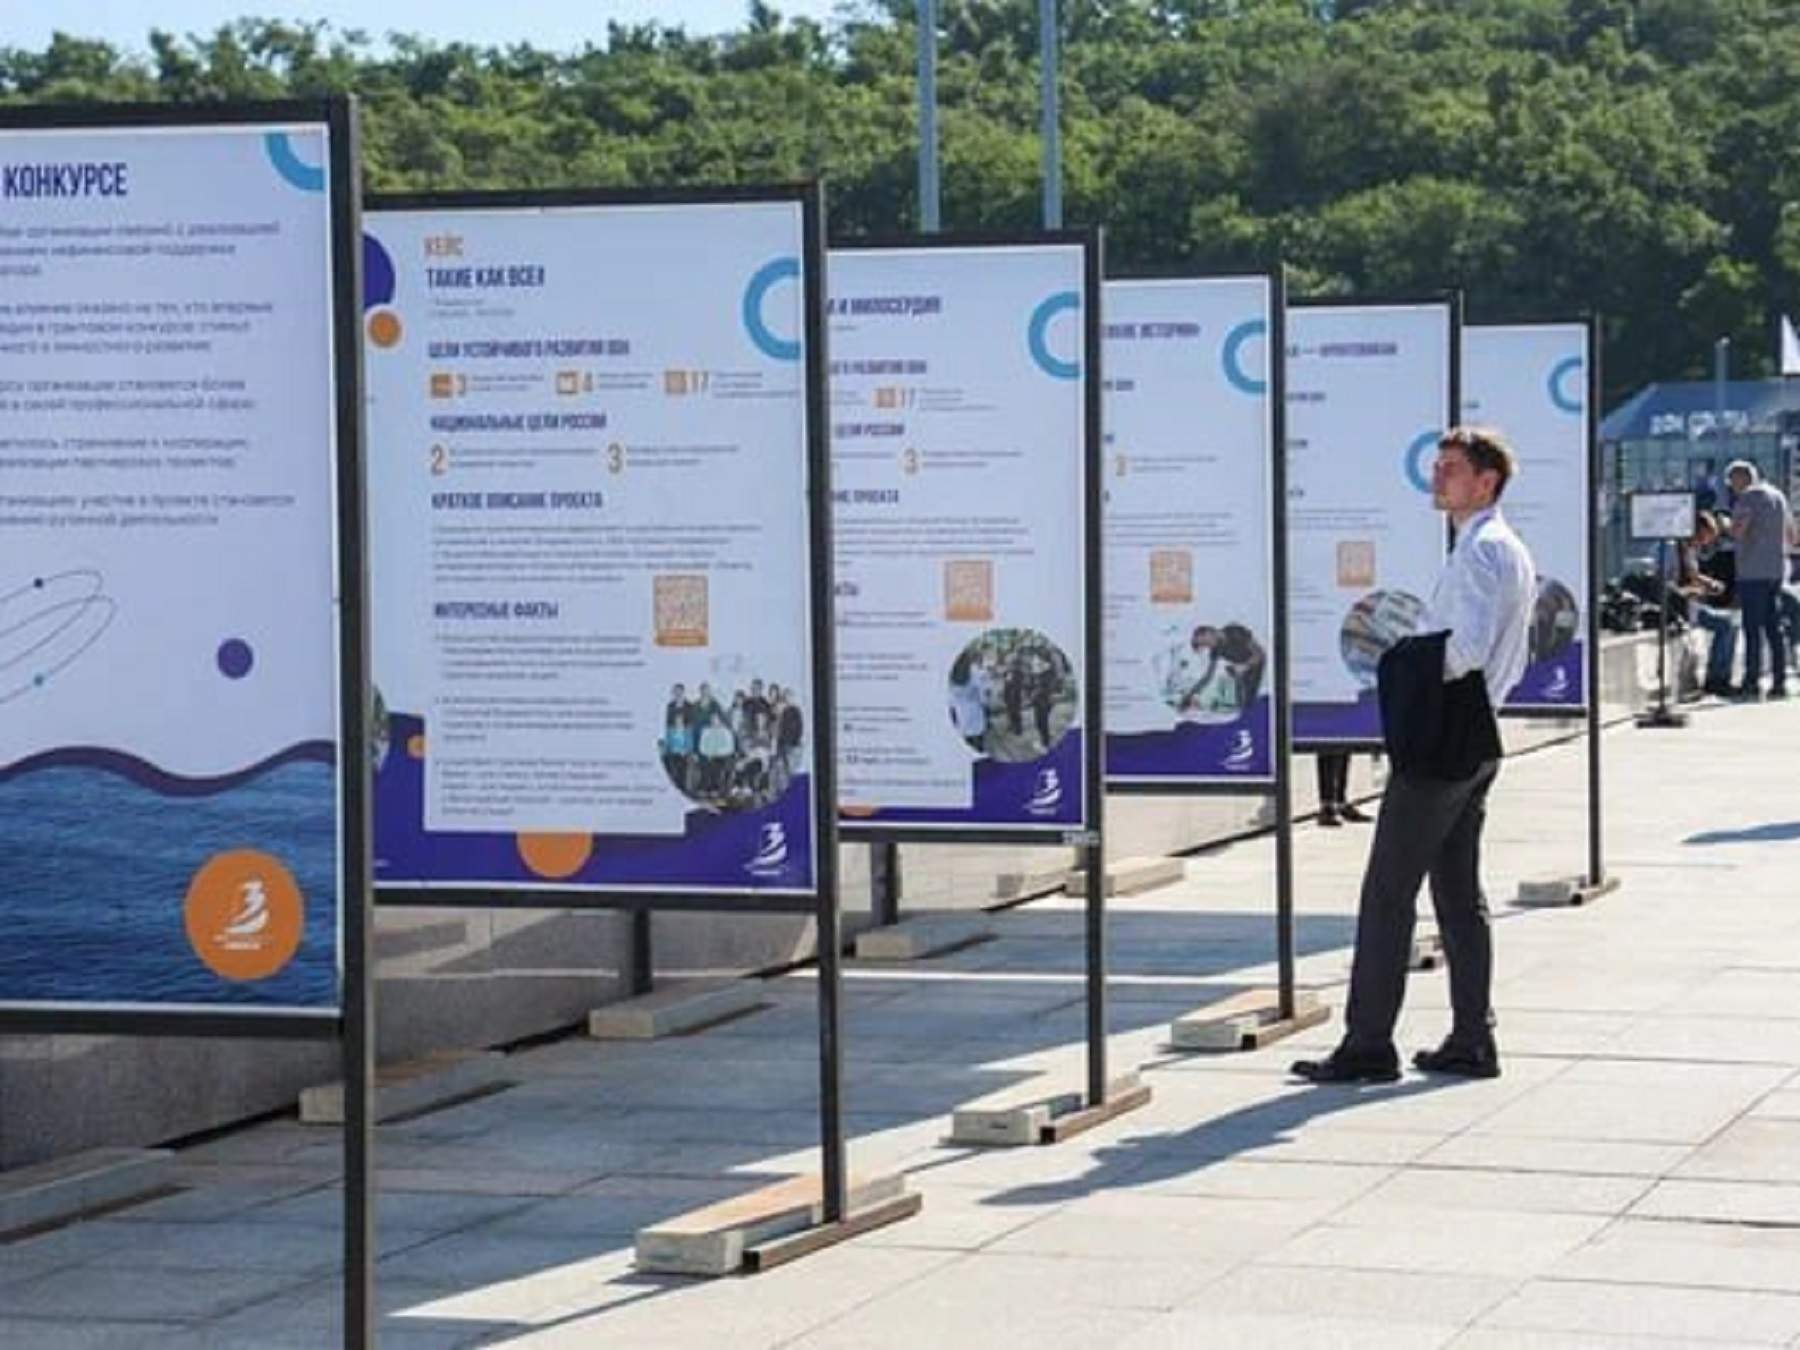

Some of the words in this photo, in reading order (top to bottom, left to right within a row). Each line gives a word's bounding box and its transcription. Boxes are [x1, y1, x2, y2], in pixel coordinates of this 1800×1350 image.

[3, 163, 128, 197] КОНКУРСЕ
[476, 267, 505, 288] КАК
[431, 443, 446, 475] 2
[608, 442, 624, 474] 3
